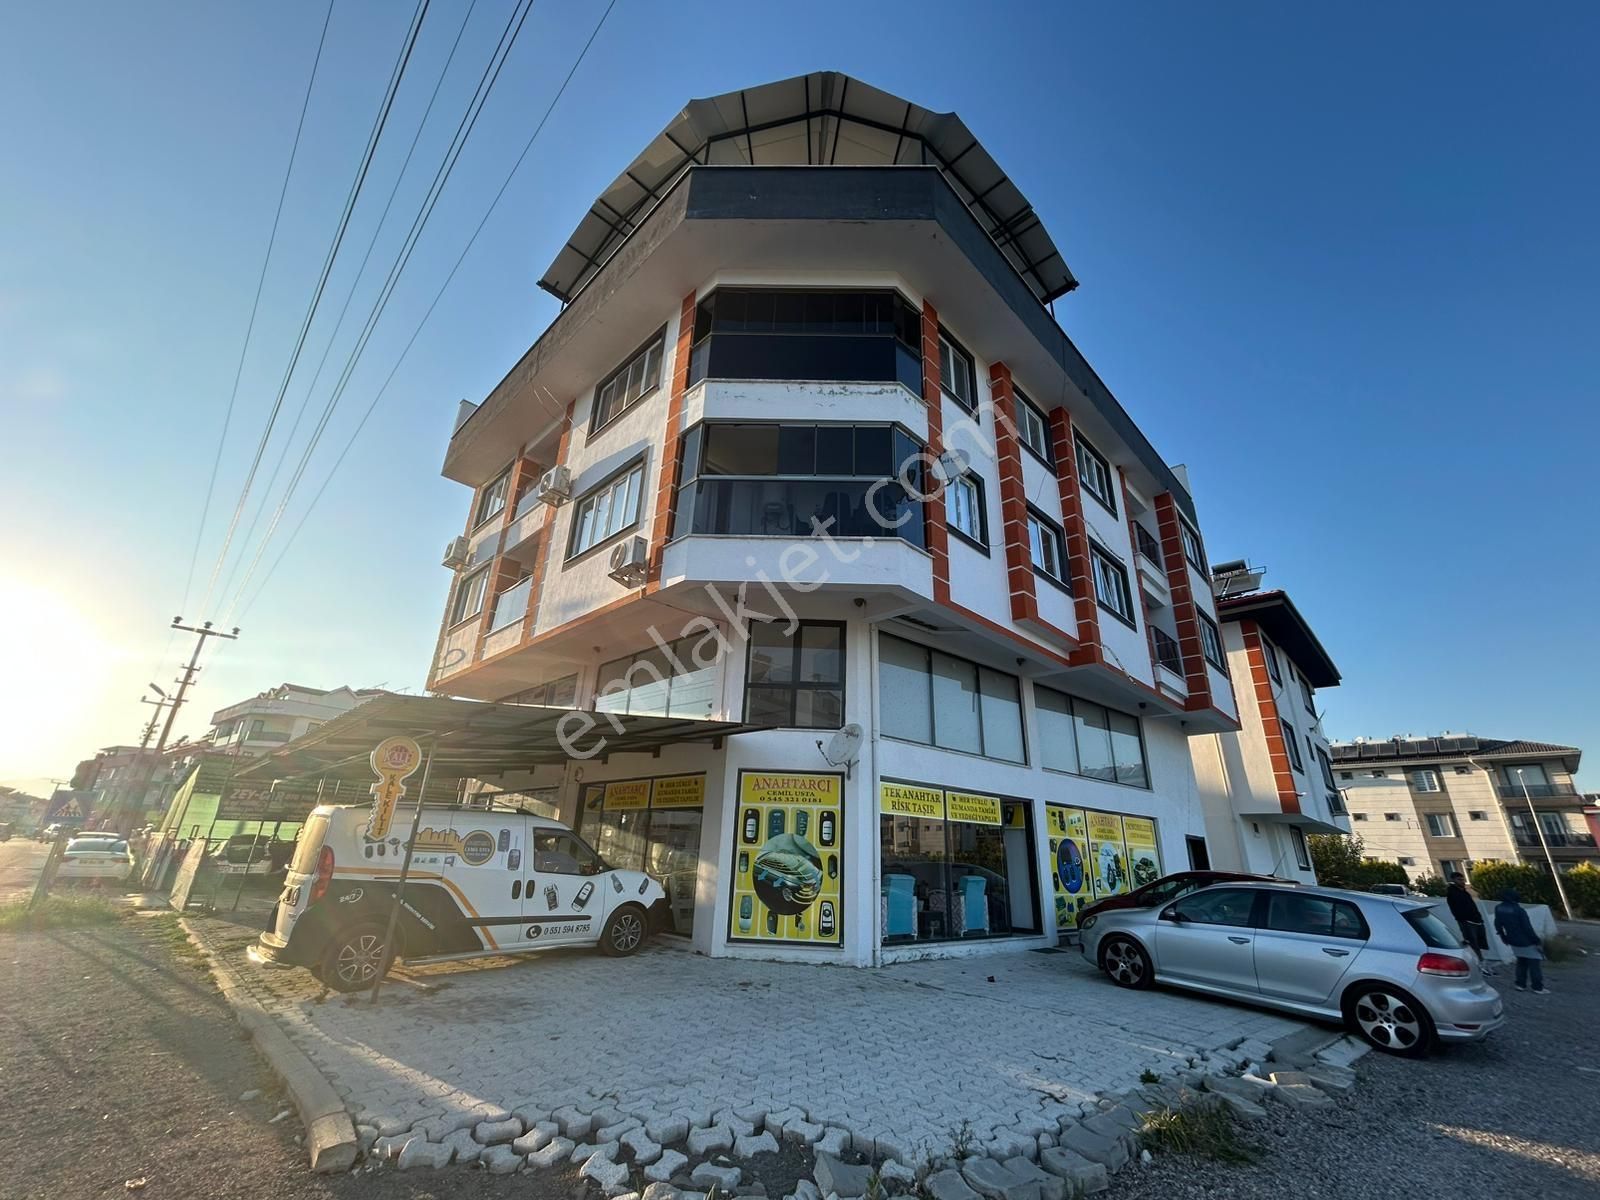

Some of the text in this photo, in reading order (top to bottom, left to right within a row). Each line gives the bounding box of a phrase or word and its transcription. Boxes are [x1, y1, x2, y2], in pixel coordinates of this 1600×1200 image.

[752, 777, 832, 793] ANAHTARCI
[884, 787, 941, 804] TEK ANAHTAR
[891, 799, 936, 816] RİSK TAŞIR
